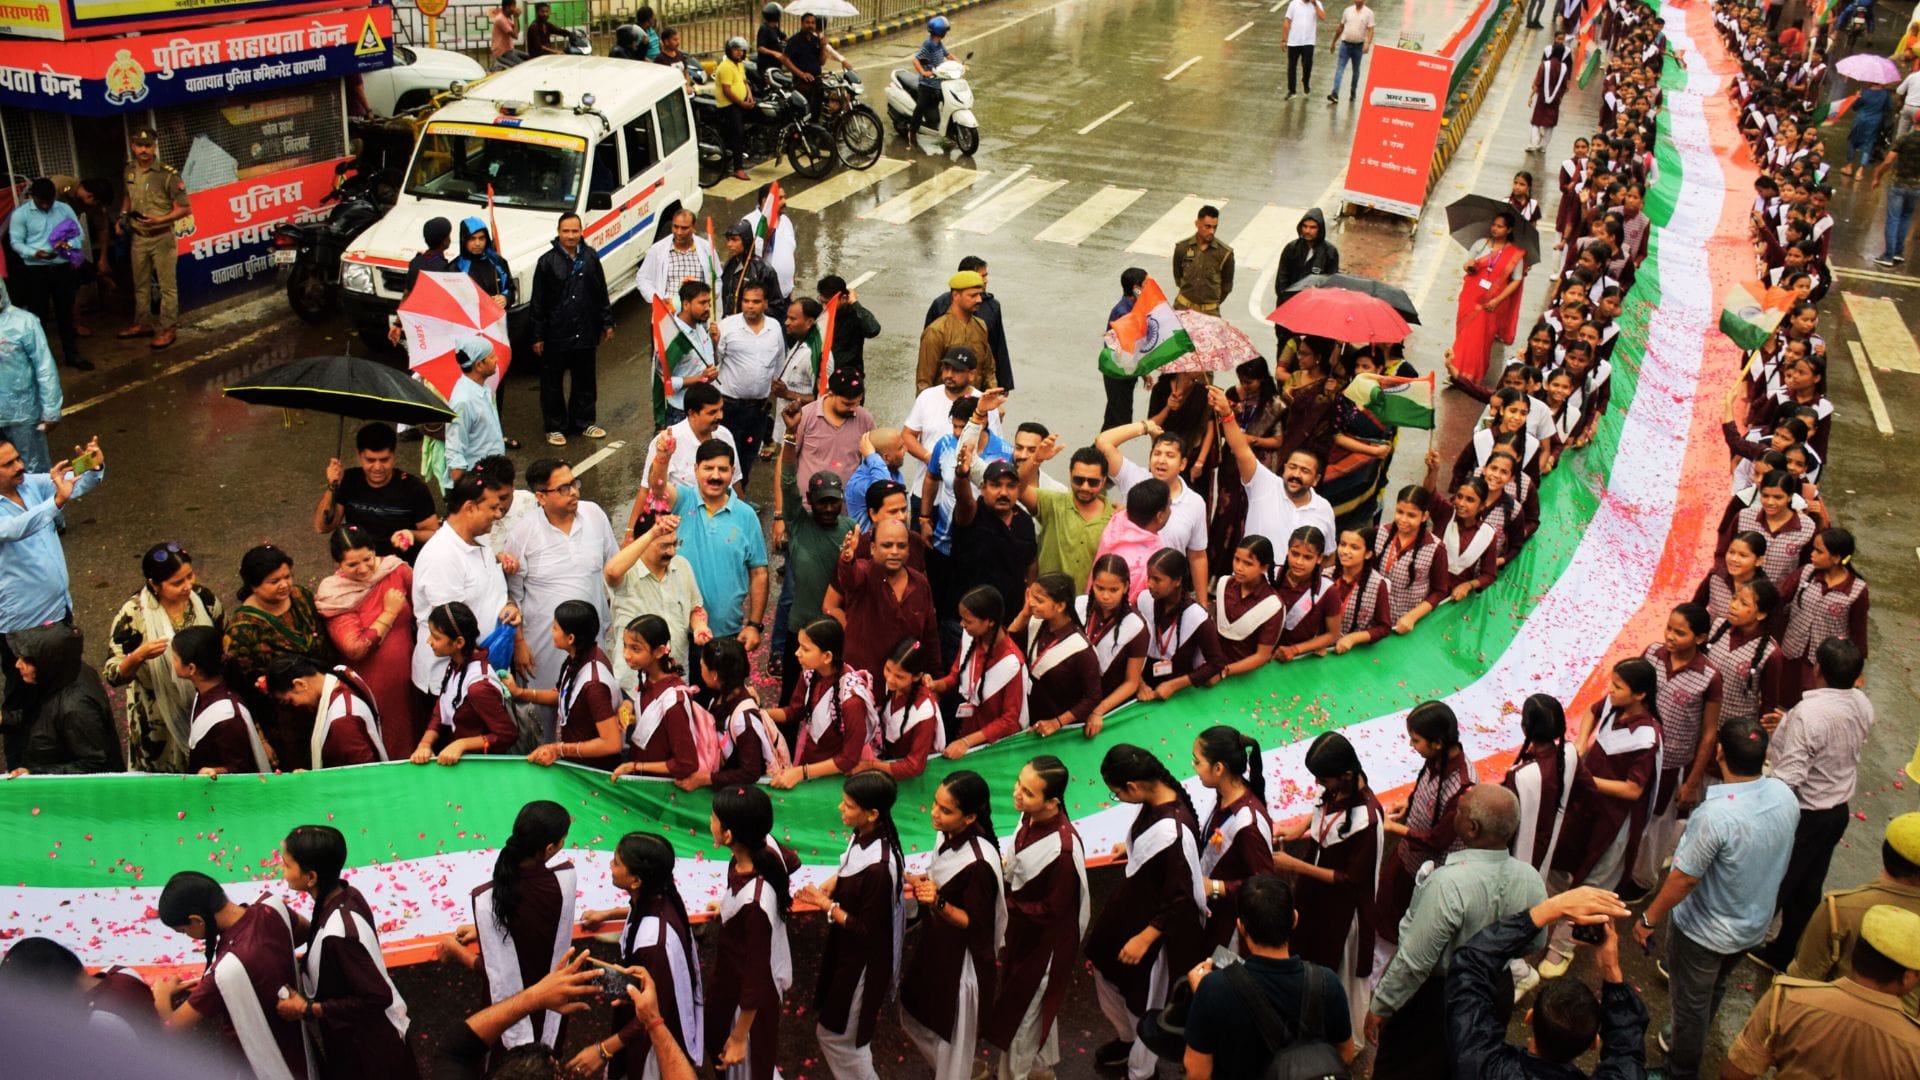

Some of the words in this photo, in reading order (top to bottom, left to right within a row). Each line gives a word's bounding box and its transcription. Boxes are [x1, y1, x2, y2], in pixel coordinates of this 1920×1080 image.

[152, 38, 221, 80] पुलिस
[226, 29, 305, 61] सहायता
[307, 20, 348, 48] केन्द्र
[39, 62, 83, 100] केन्द्र
[185, 74, 224, 92] यातायात
[225, 67, 252, 91] पुलिस
[293, 55, 327, 76] वाराणसी
[229, 181, 303, 223] पुलिस
[190, 216, 288, 260] सहायत
[211, 262, 244, 285] यातायात
[244, 254, 268, 281] पुलिस
[415, 322, 427, 350] SERVO
